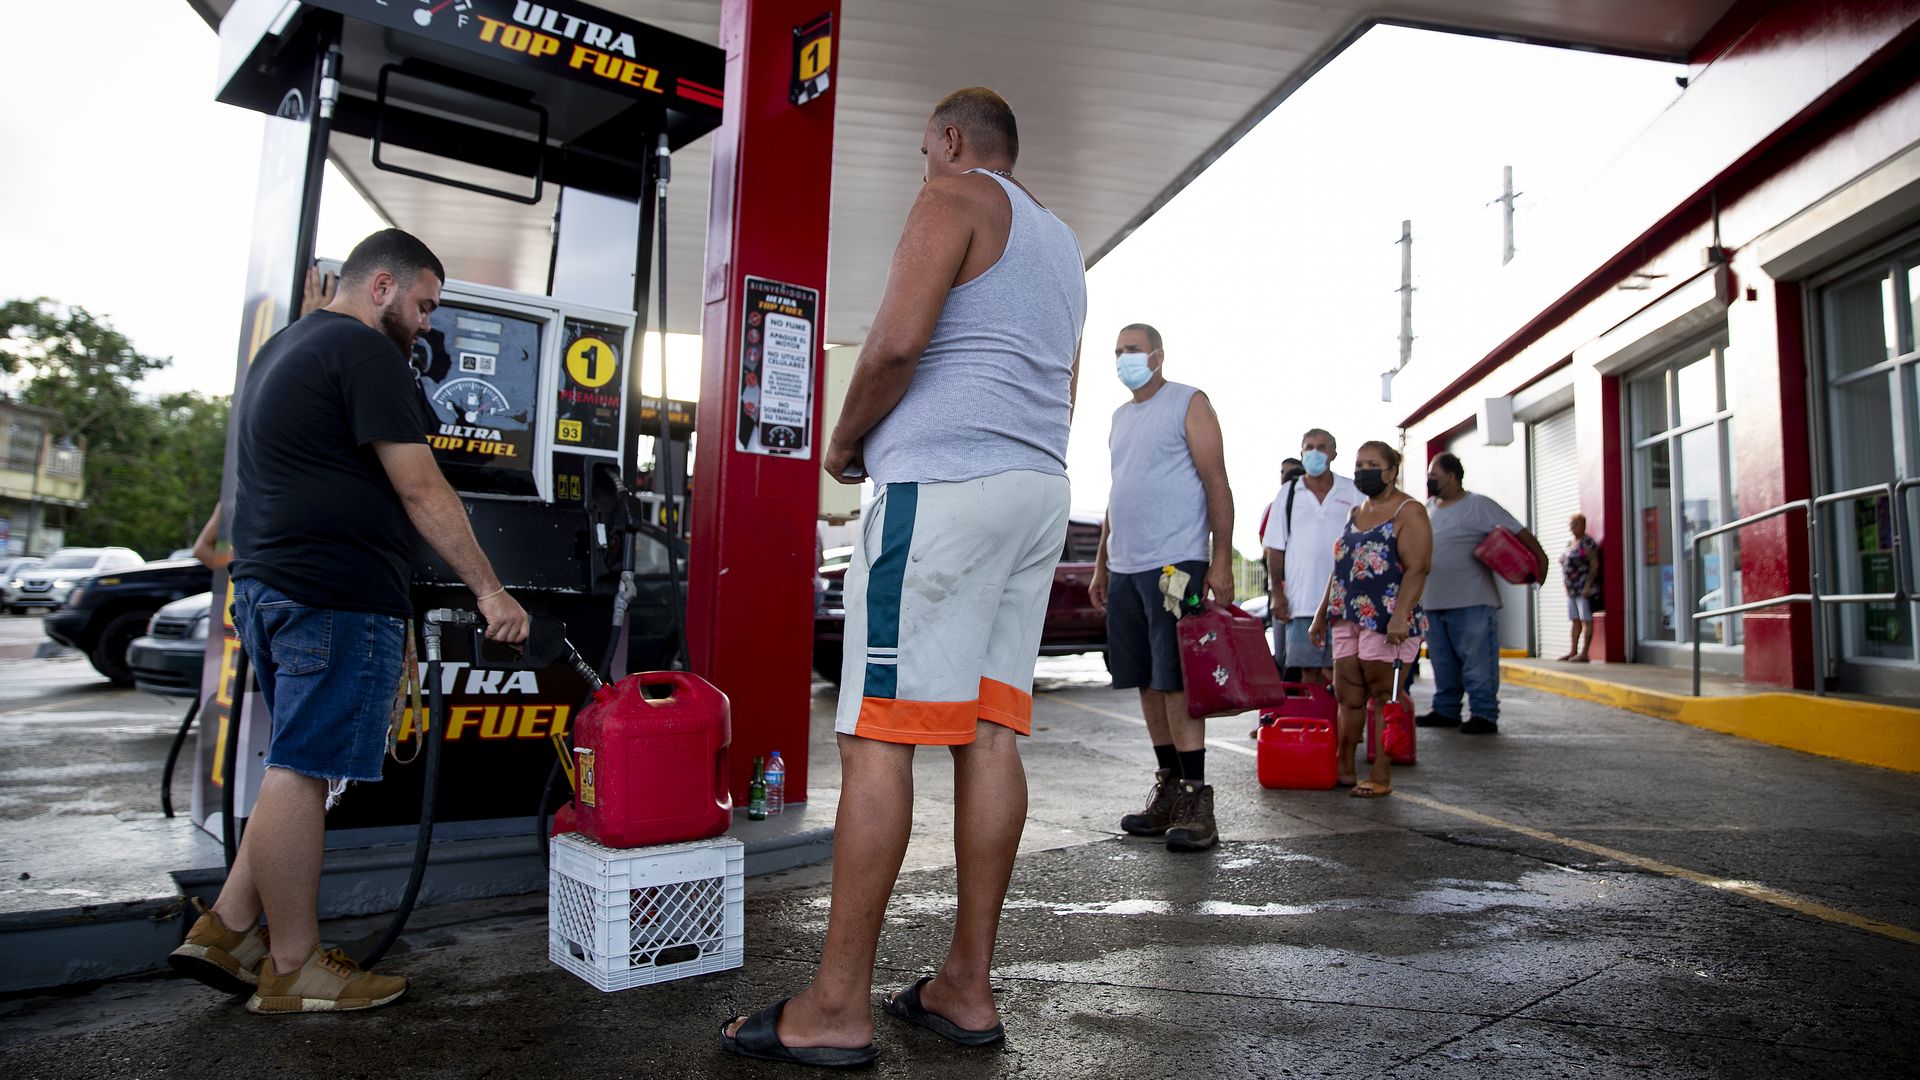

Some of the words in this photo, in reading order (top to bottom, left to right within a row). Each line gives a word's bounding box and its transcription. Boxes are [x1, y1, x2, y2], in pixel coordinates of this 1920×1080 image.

[513, 0, 637, 58] ULTRA
[477, 15, 560, 57] TOP
[568, 44, 664, 94] FUEL
[808, 42, 819, 73] 1
[765, 294, 797, 307] ULTRA
[770, 319, 783, 327] NO
[785, 322, 806, 331] FUME
[580, 345, 598, 380] 1
[560, 388, 619, 407] PREMIUM
[439, 424, 502, 440] ULTRA
[562, 427, 578, 439] 93
[466, 440, 517, 457] FUEL
[403, 662, 539, 694] LTRA
[445, 704, 570, 740] FUEL
